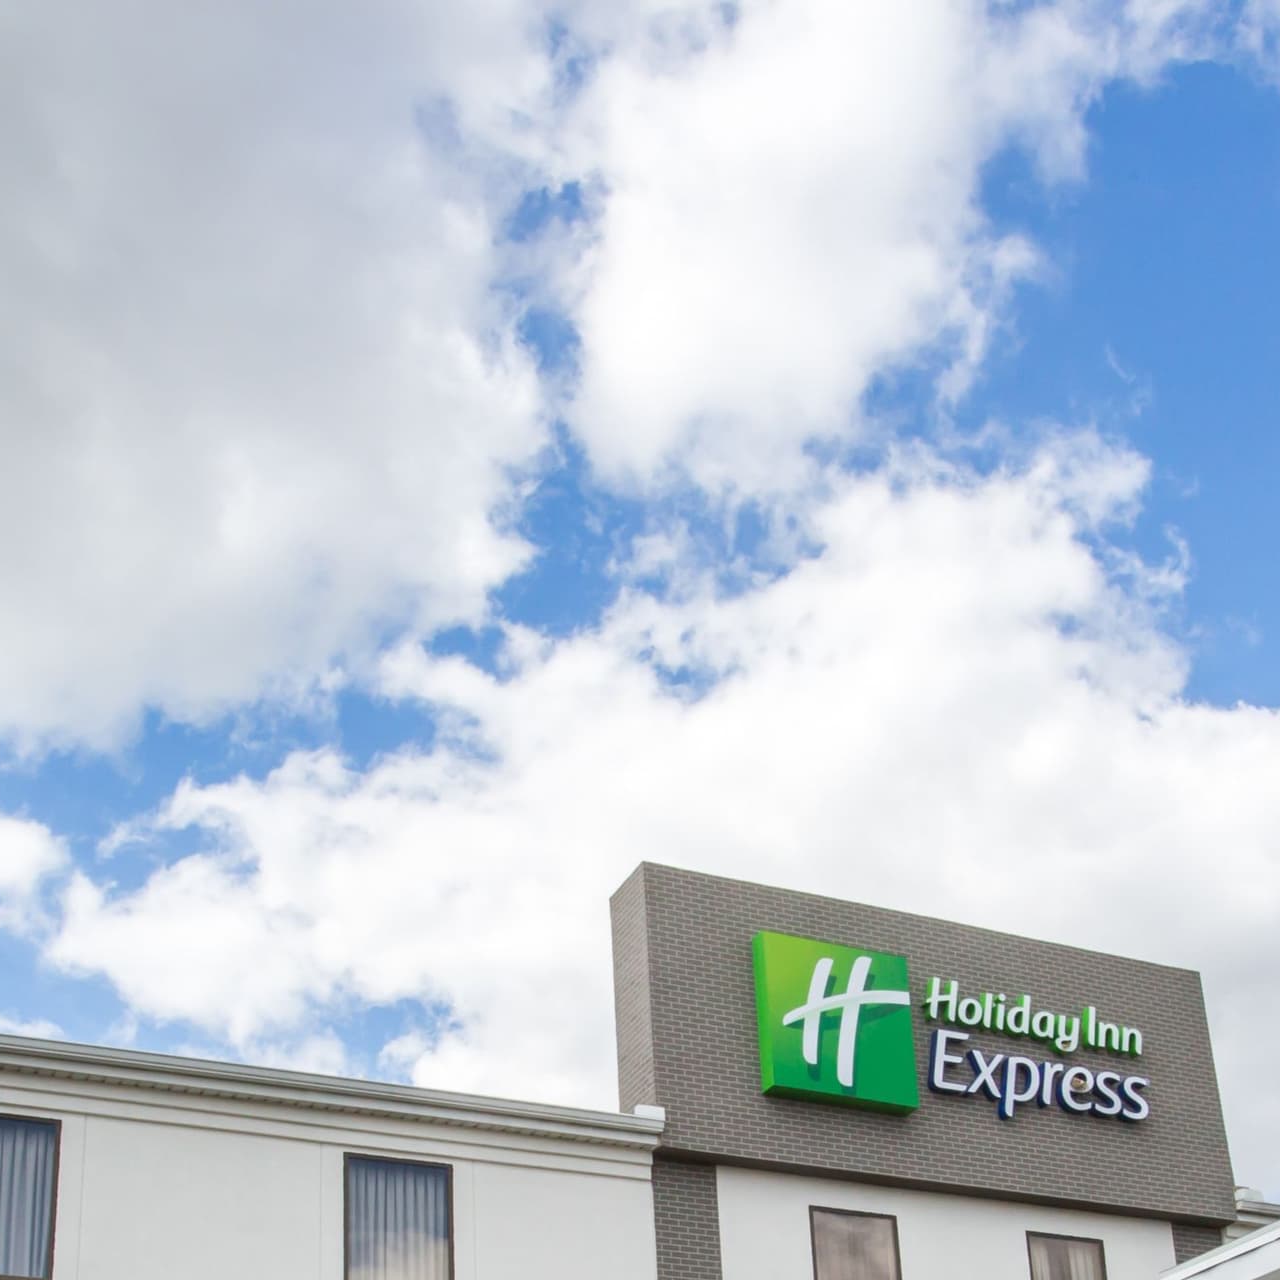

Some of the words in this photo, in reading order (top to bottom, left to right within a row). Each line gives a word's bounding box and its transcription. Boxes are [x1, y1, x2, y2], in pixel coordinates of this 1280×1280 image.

[924, 976, 1080, 1053] Holiday
[1083, 1005, 1143, 1056] Inn
[929, 1028, 1151, 1121] Express
